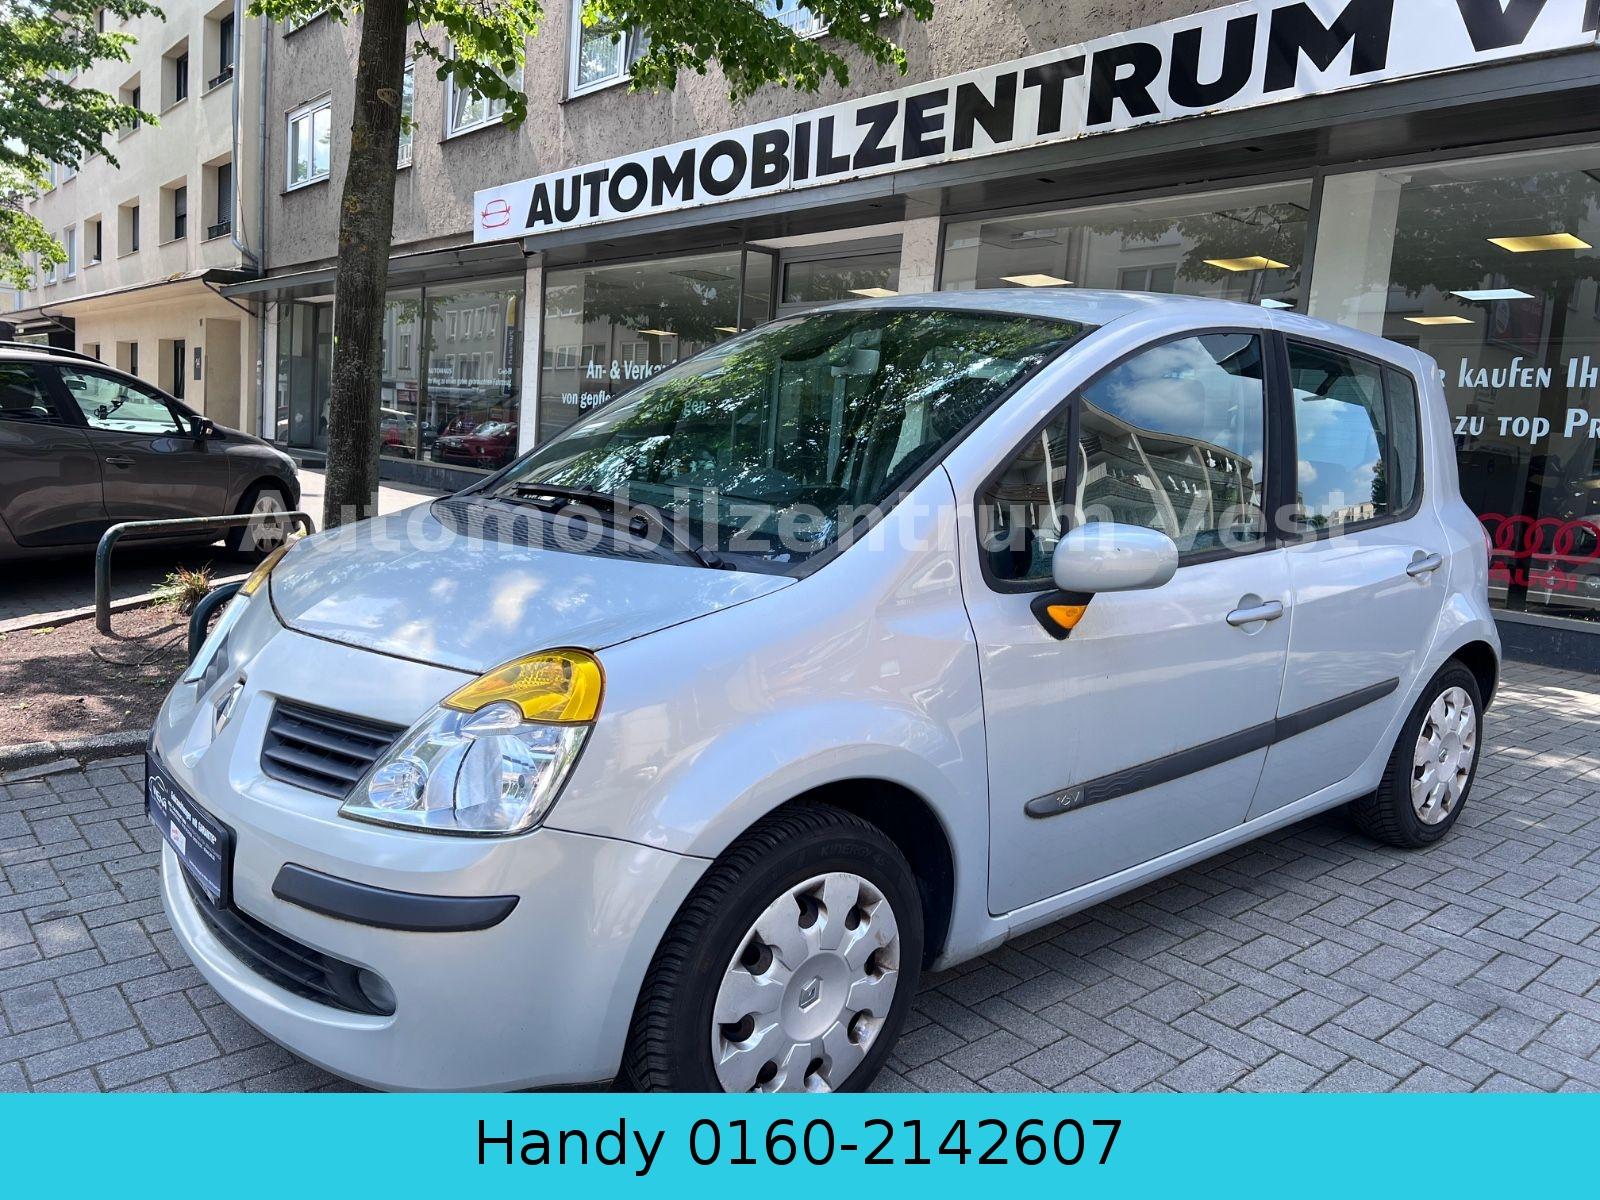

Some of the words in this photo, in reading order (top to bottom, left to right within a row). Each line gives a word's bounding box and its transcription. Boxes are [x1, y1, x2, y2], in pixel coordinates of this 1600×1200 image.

[525, 0, 1394, 229] AUTOMOBILZENTRUM
[586, 360, 606, 379] An-
[610, 360, 620, 379] &
[562, 392, 578, 405] von
